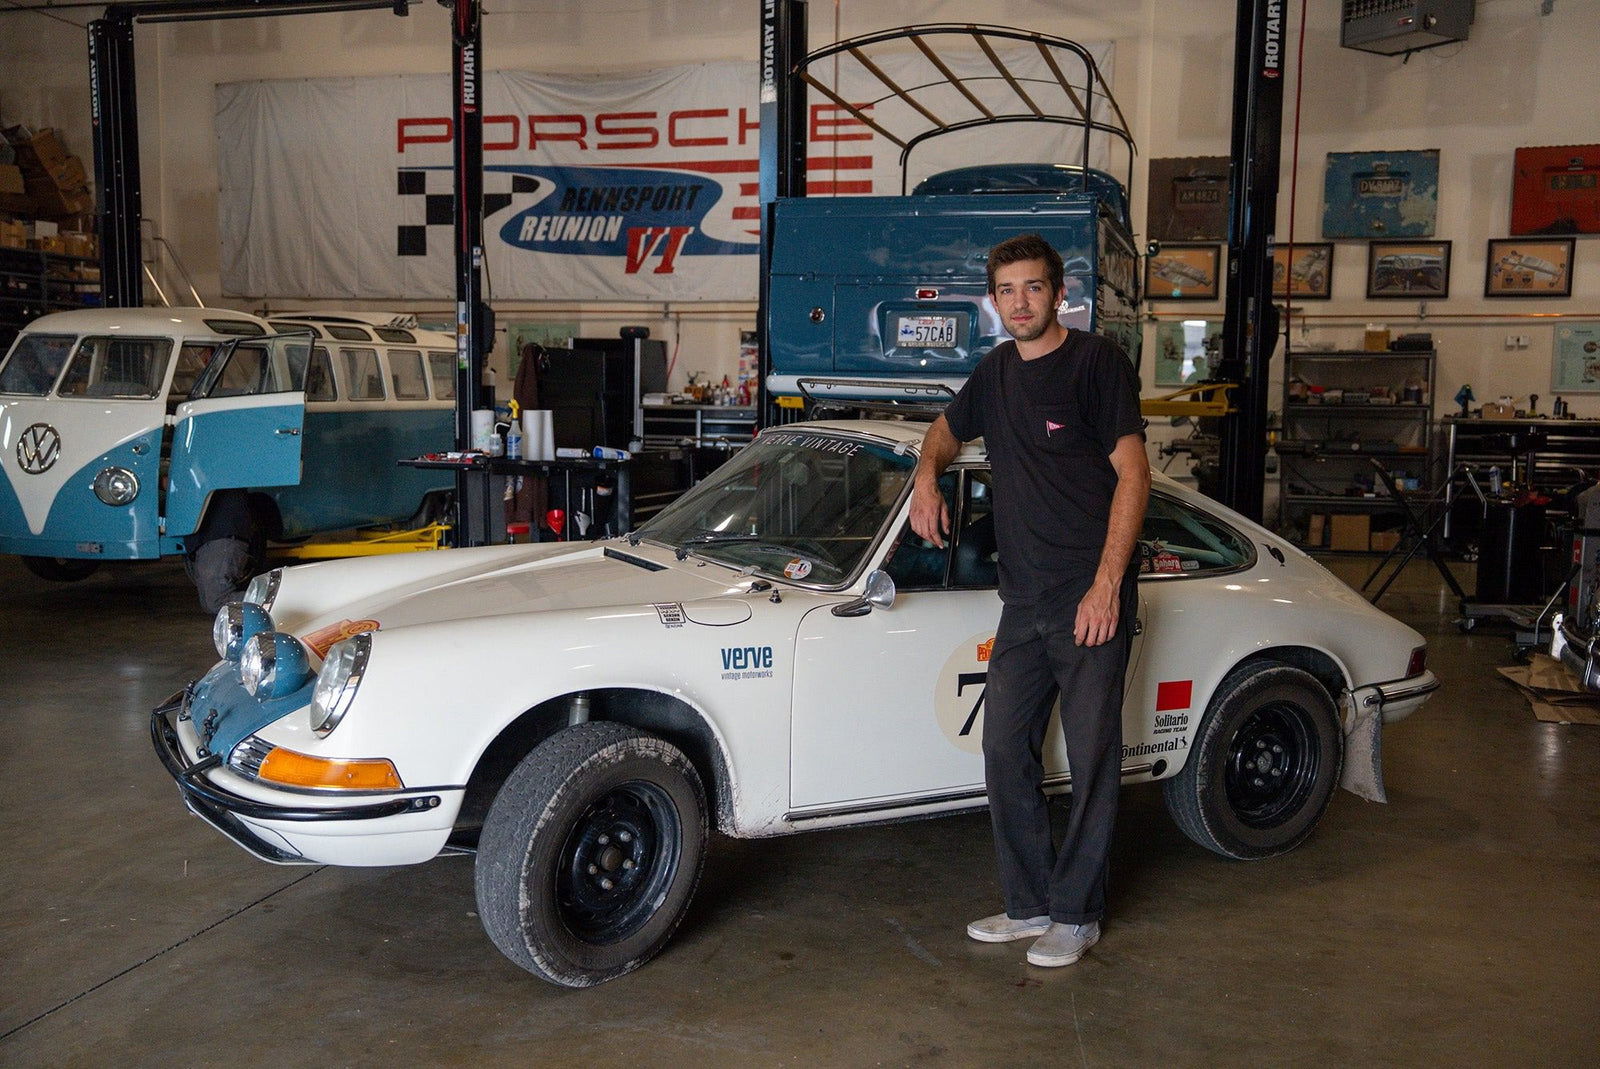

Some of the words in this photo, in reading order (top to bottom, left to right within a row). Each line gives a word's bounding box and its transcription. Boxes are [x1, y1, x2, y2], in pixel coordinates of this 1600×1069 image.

[763, 25, 775, 91] ROTARY
[559, 185, 703, 213] RENNSPORT
[518, 215, 624, 242] REUNION
[625, 226, 695, 274] VI
[916, 326, 953, 342] 57CAB
[800, 437, 865, 457] VINTAGE
[720, 646, 773, 670] verve
[720, 672, 742, 681] vintage
[741, 670, 773, 679] motorworks
[957, 672, 988, 736] 7
[1154, 713, 1189, 728] Solitario
